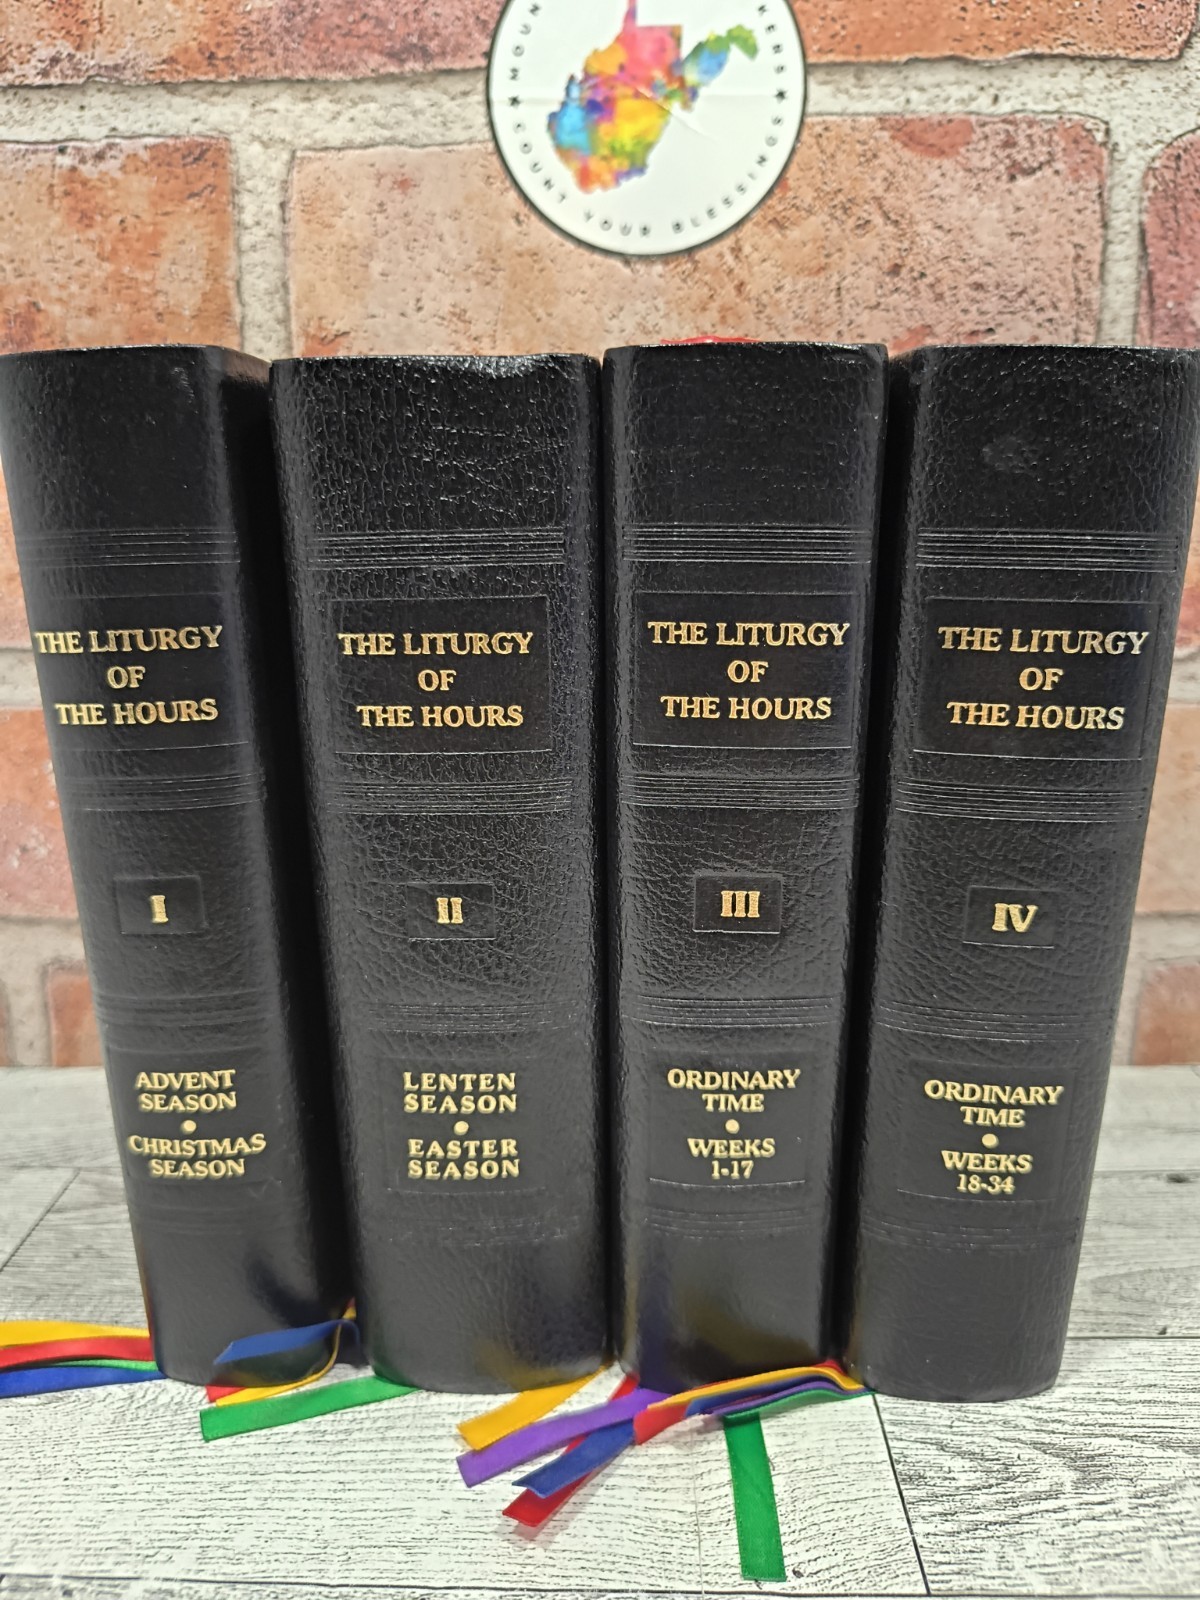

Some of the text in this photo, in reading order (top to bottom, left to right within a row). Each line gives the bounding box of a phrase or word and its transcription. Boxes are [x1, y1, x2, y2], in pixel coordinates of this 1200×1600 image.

[510, 2, 542, 81] MOUN
[757, 3, 787, 75] KERS
[514, 115, 783, 236] COUNT YOUR BLESSINGS
[35, 624, 223, 655] THE LITURGY
[337, 631, 534, 656] THE LITURGY
[647, 621, 850, 647] THE LITURGY
[937, 626, 1149, 656] THE LITURGY
[106, 665, 146, 690] OF
[416, 669, 457, 693] OF
[726, 659, 769, 684] OF
[1018, 667, 1064, 692] OF
[54, 697, 219, 727] THE HOURS
[356, 704, 524, 728] THE HOURS
[660, 695, 832, 721] THE HOURS
[946, 701, 1126, 731] THE HOURS
[149, 894, 169, 925] I
[435, 896, 464, 925] II
[720, 889, 761, 919] III
[991, 902, 1039, 933] IV
[134, 1068, 237, 1093] ADVENT
[402, 1071, 517, 1094] LENTEN
[667, 1068, 802, 1091] ORDINARY
[139, 1091, 237, 1114] SEASON
[402, 1093, 518, 1115] SEASON
[701, 1092, 765, 1114] TIME
[923, 1078, 1065, 1107] ORDINARY
[959, 1105, 1026, 1129] TIME
[127, 1132, 267, 1158] CHRISTMAS
[407, 1138, 519, 1161] EASTER
[686, 1137, 777, 1160] WEEKS
[148, 1157, 246, 1180] SEASON
[406, 1158, 520, 1181] SEASON
[709, 1158, 755, 1181] 1-17
[940, 1149, 1034, 1174] WEEKS
[955, 1173, 1016, 1196] 18-34
